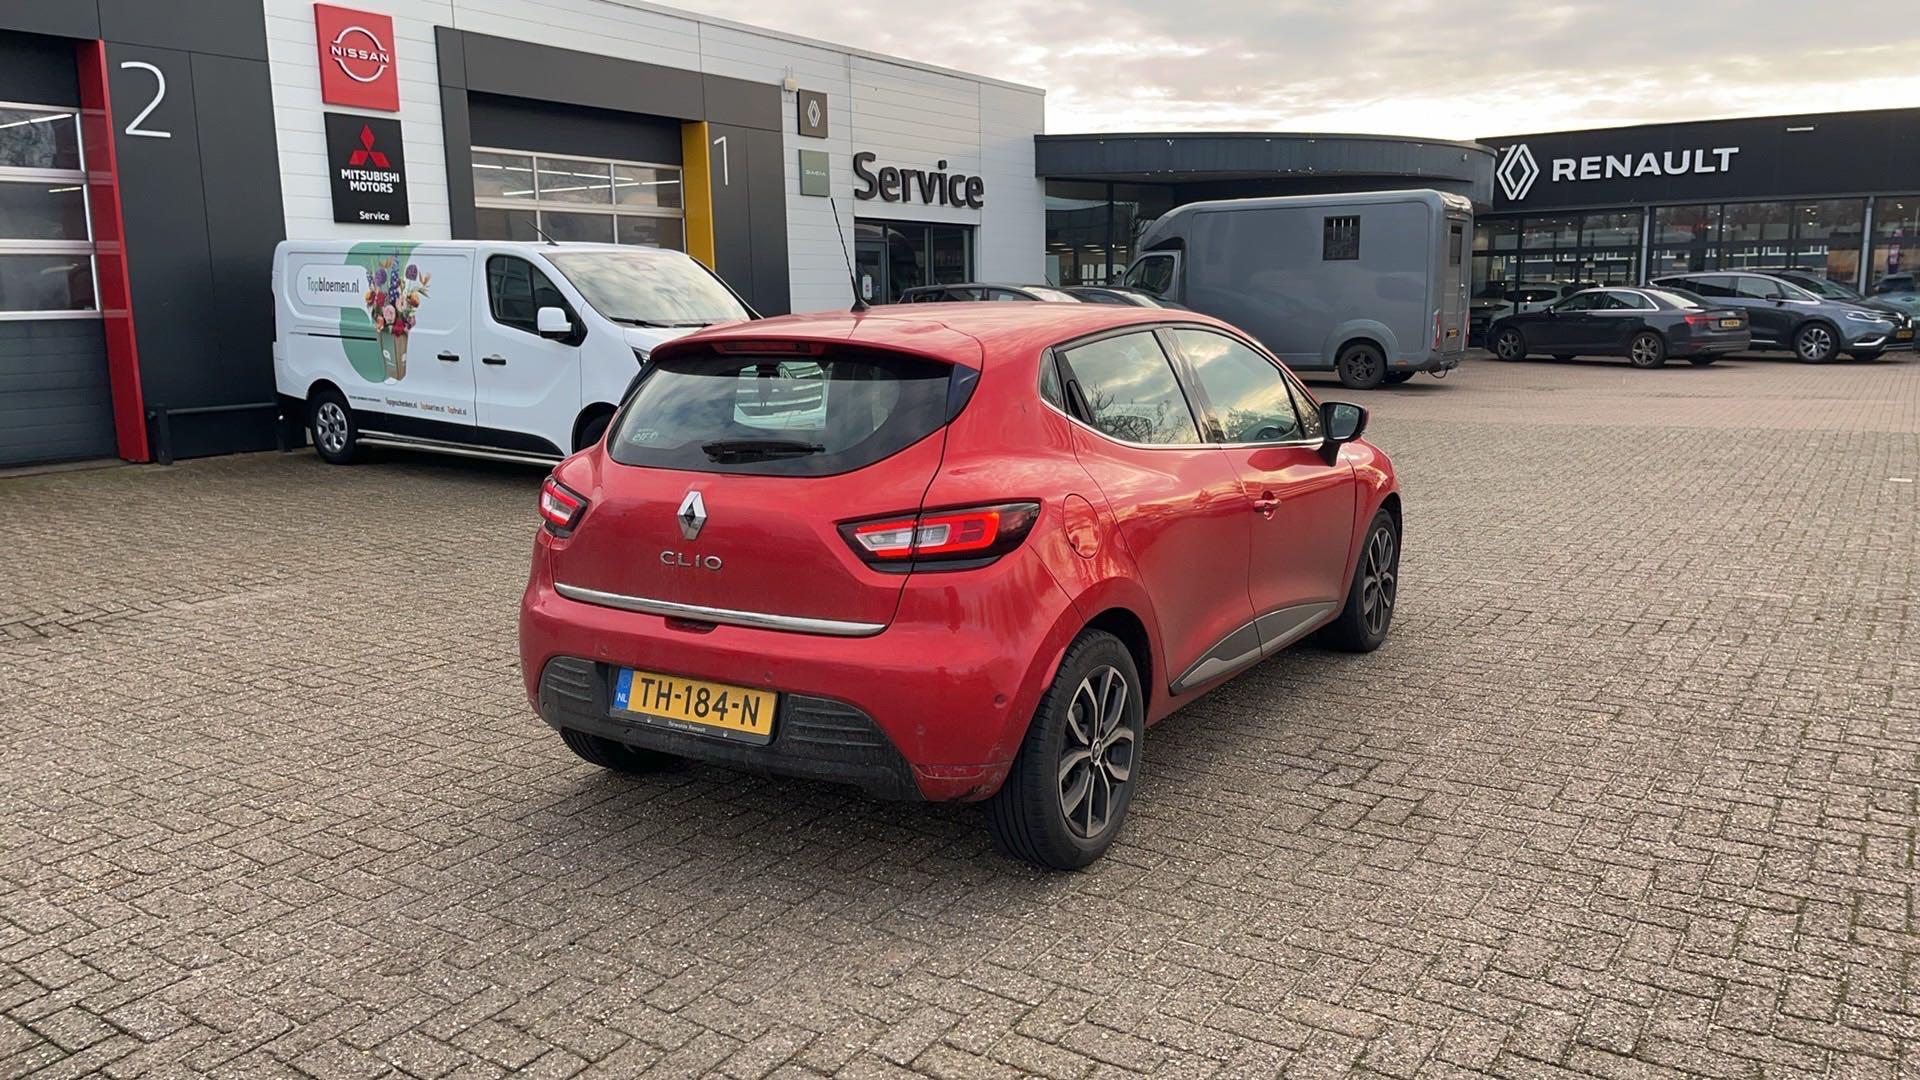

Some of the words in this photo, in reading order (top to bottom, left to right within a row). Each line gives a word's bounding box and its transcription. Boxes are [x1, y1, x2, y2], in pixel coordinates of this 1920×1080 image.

[330, 45, 390, 63] NISSAN
[121, 61, 171, 138] 2
[713, 136, 728, 186] 1
[1552, 147, 1740, 182] RENAULT
[341, 168, 400, 183] MITSUBISHI
[853, 151, 984, 209] Service
[350, 180, 394, 194] MOTORS
[359, 210, 390, 221] Service
[307, 276, 360, 295] Topbloemen.nl
[660, 550, 722, 570] CLIO
[616, 692, 628, 703] NL
[641, 677, 761, 727] TH-184-N
